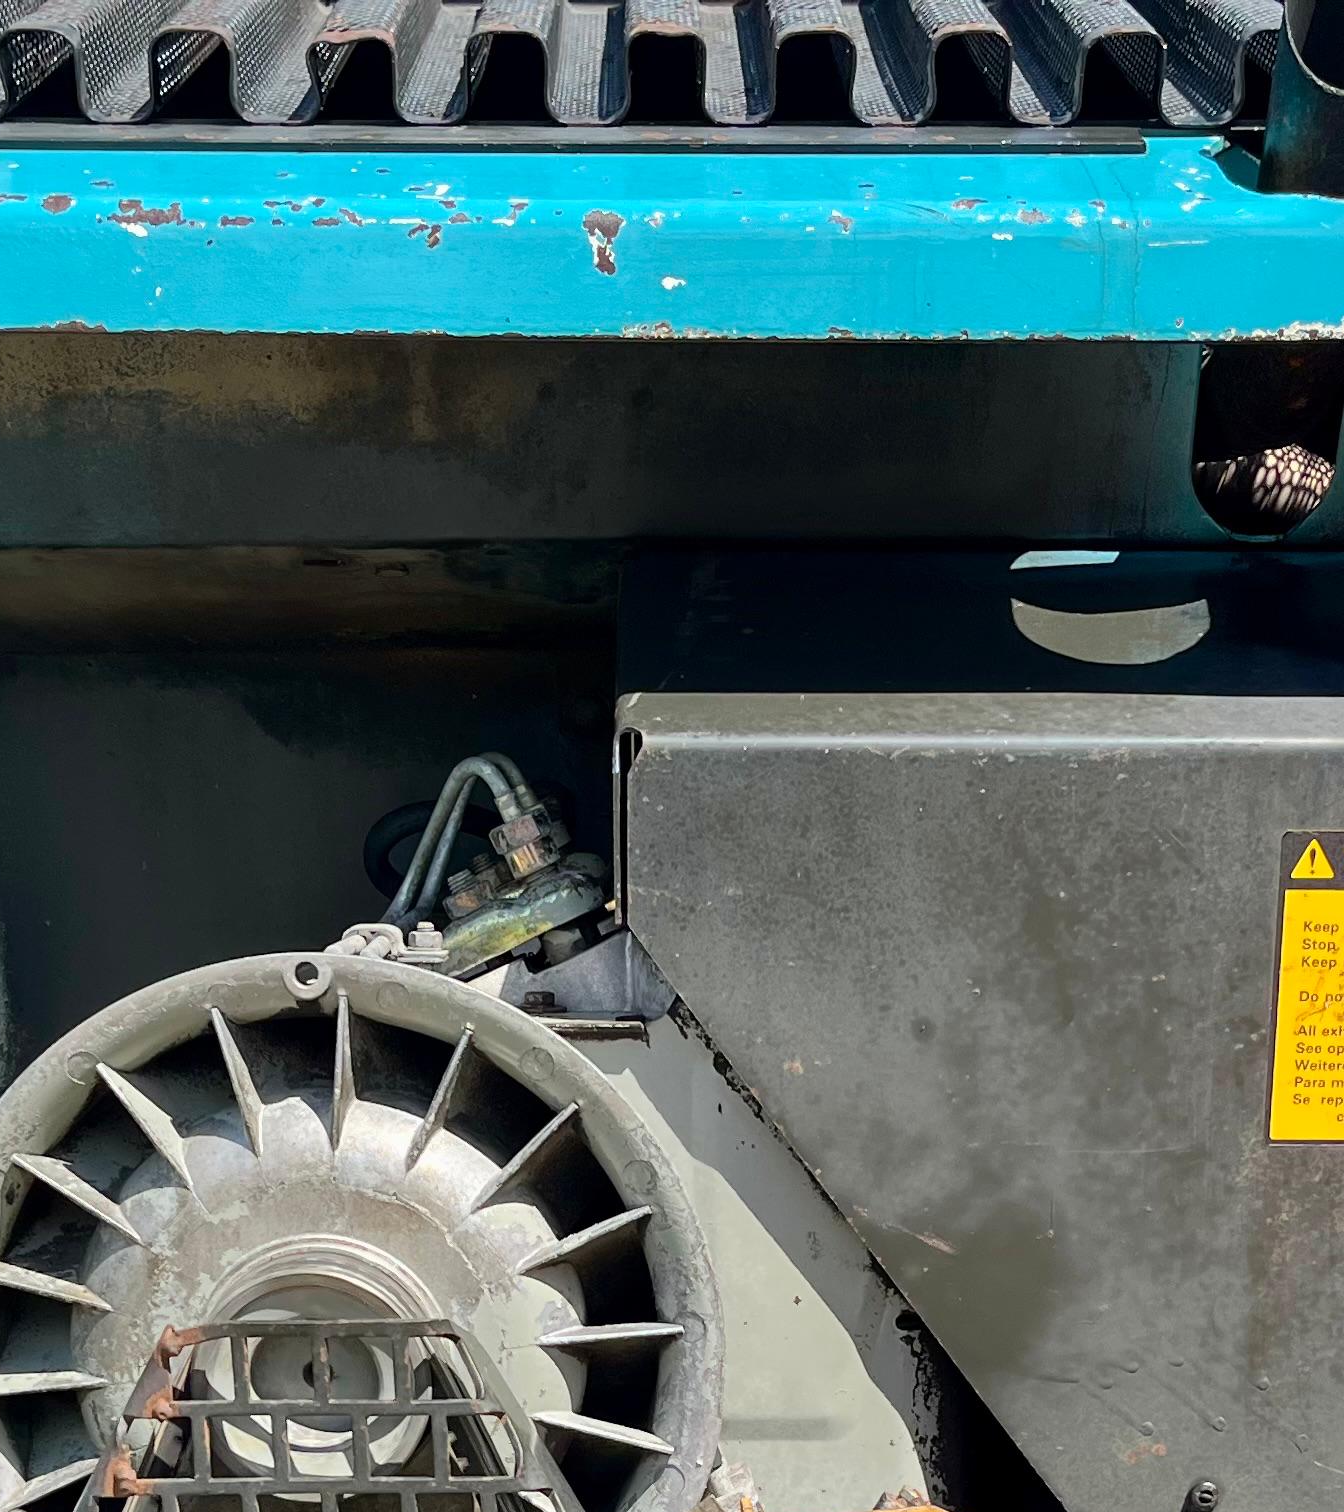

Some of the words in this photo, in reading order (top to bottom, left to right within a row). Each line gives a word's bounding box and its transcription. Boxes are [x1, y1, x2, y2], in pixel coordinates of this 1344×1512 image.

[1303, 920, 1340, 936] Keep
[1301, 955, 1338, 971] Keep
[1298, 990, 1320, 1003] Do
[1296, 1024, 1317, 1038] All
[1295, 1041, 1323, 1055] See
[1293, 1076, 1326, 1089] Para
[1292, 1093, 1311, 1106] Se
